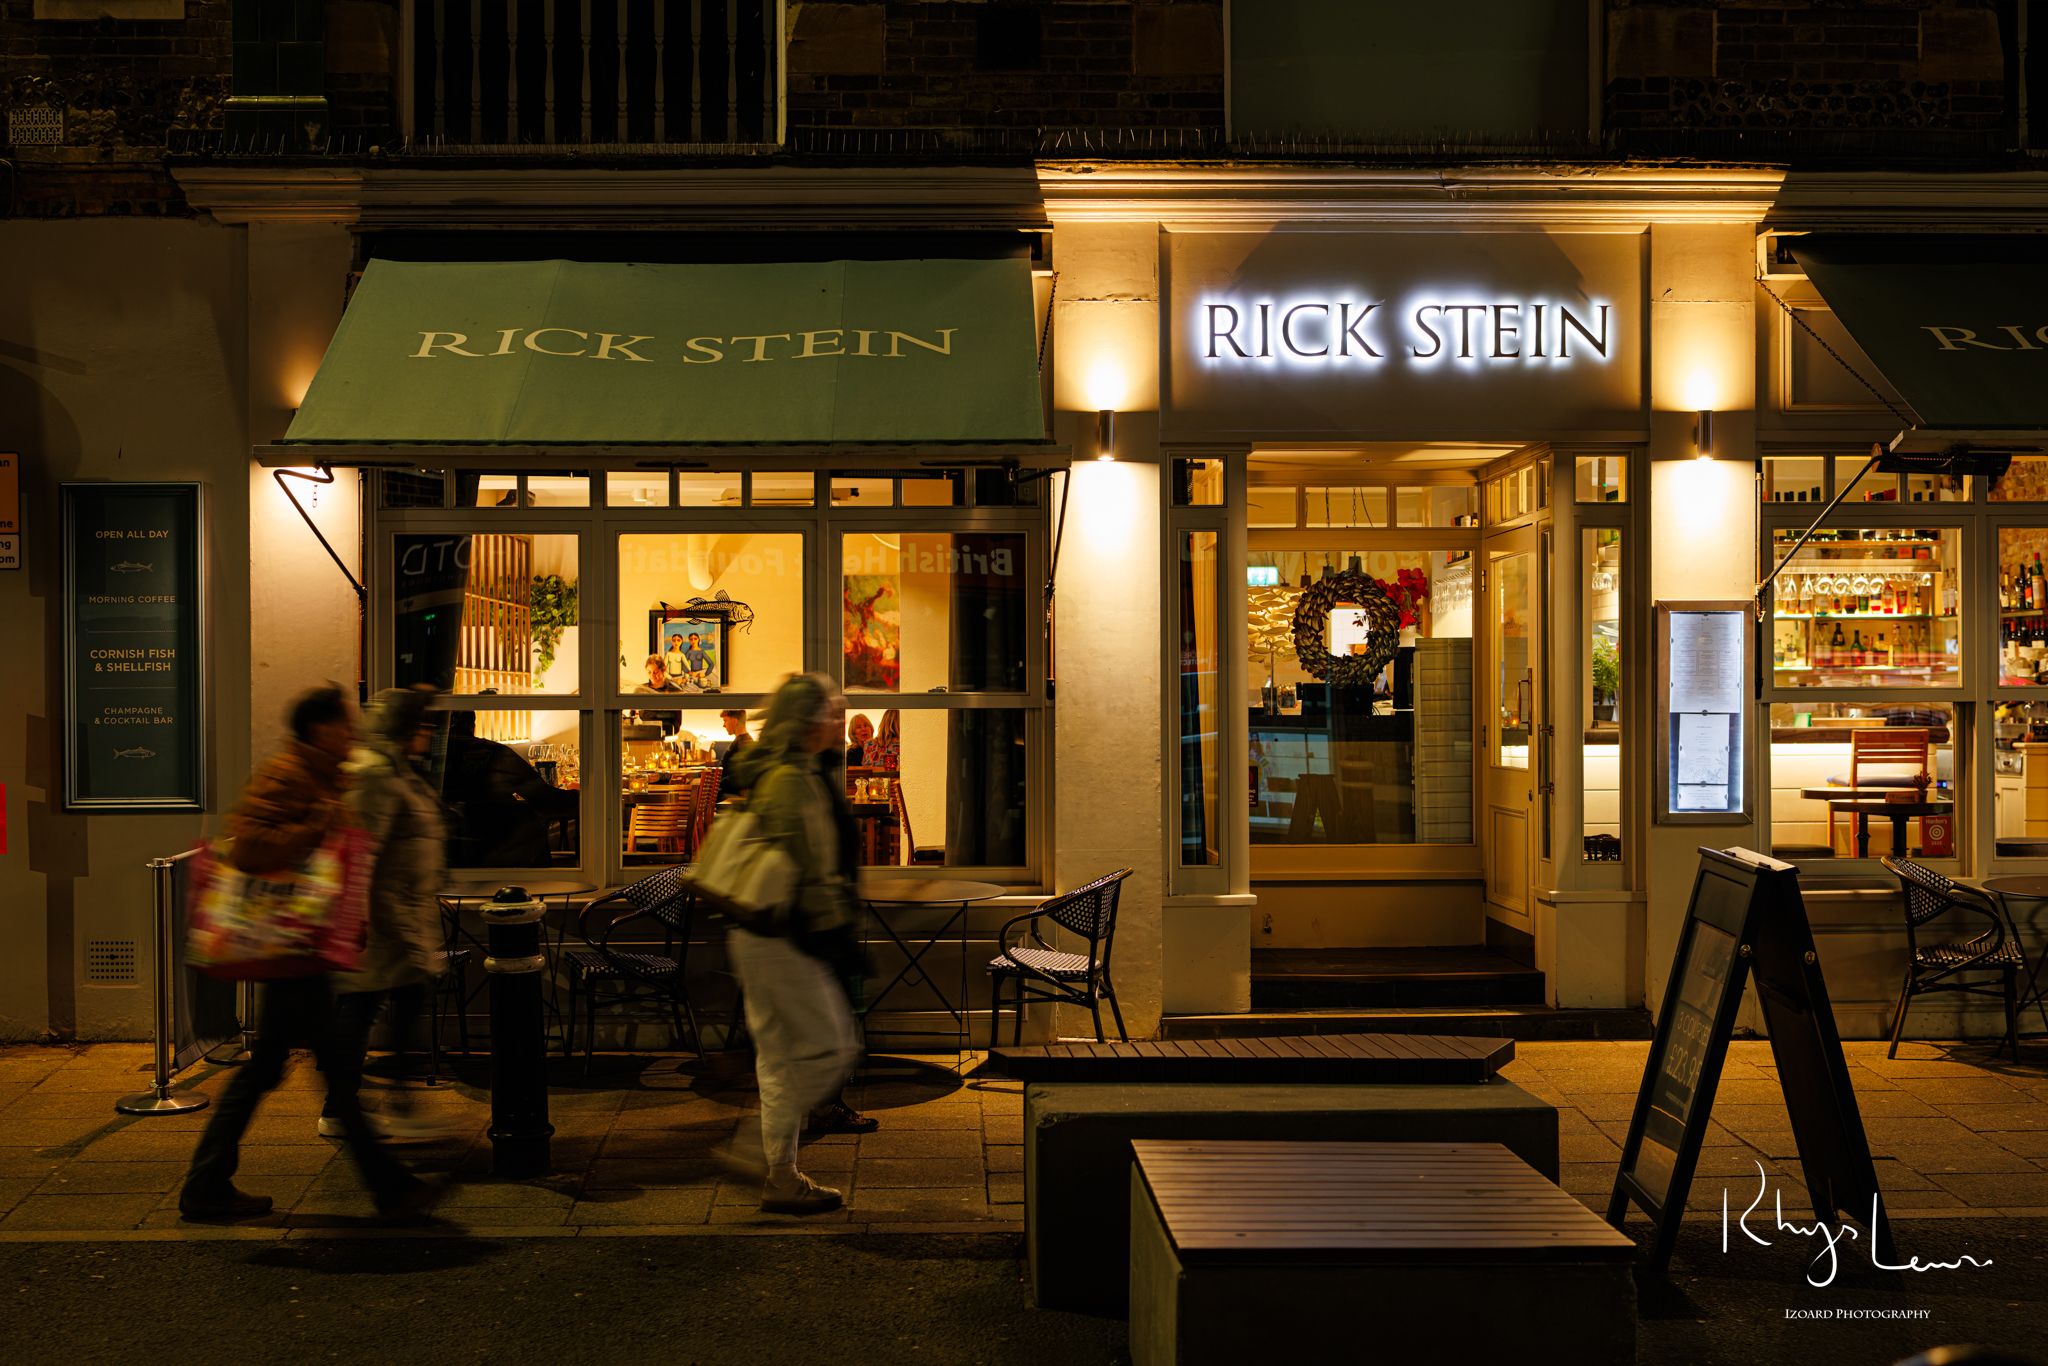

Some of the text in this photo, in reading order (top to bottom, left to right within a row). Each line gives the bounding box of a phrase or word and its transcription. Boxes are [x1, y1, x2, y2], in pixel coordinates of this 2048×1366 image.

[1203, 303, 1613, 359] RICK STEIN
[1920, 325, 2048, 351] RI
[409, 327, 958, 364] RICK STEIN
[95, 529, 169, 539] OPEN ALL DAY
[88, 595, 176, 604] MORNING COFFEE
[90, 648, 176, 659] CORNISH FISH
[94, 662, 171, 672] & SHELLFISH
[104, 707, 163, 715] CHAMPAGNE
[94, 716, 174, 725] & COCKTAIL BAR
